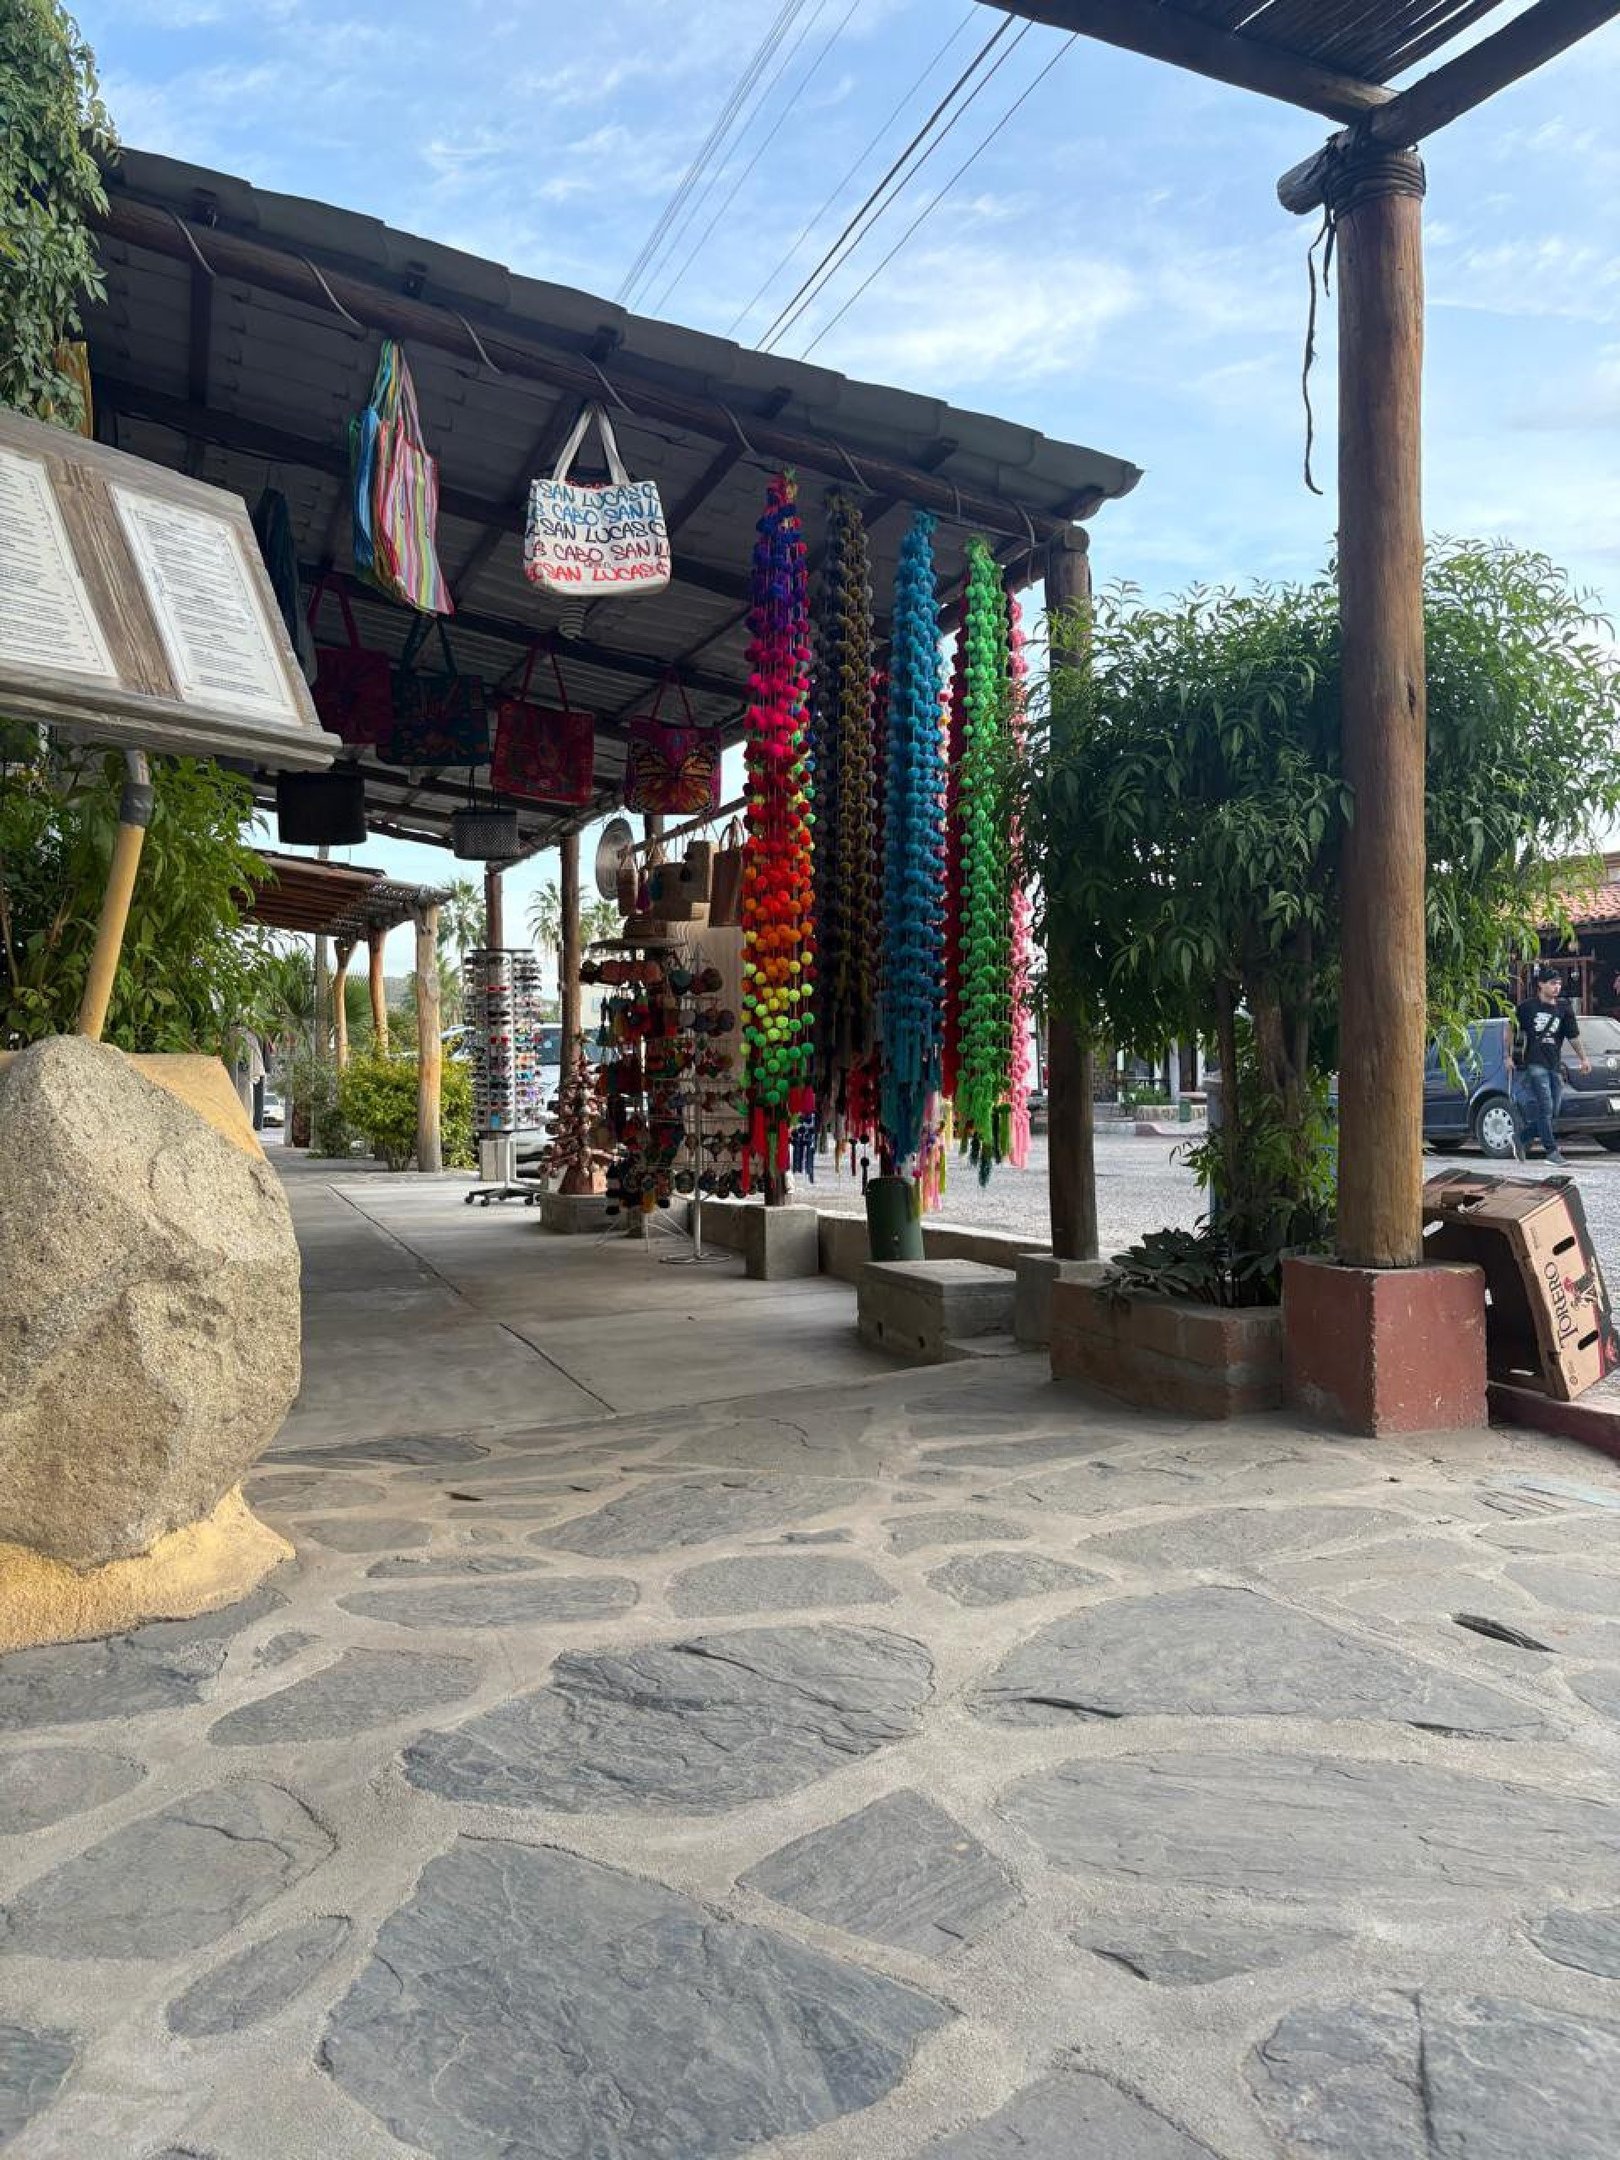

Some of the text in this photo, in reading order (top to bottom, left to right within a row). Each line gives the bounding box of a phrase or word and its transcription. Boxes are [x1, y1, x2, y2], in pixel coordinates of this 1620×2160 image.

[540, 481, 575, 503] SAN
[582, 485, 642, 509] LUCAS
[552, 503, 600, 526] CABO
[604, 502, 644, 524] SAN
[541, 518, 576, 541] SAN
[585, 520, 649, 544] LUCAS
[553, 544, 604, 564] CABO
[610, 539, 651, 561] SAN
[543, 564, 582, 581] SAN
[591, 562, 655, 582] LUCAS
[1544, 1261, 1579, 1349] TORERO
